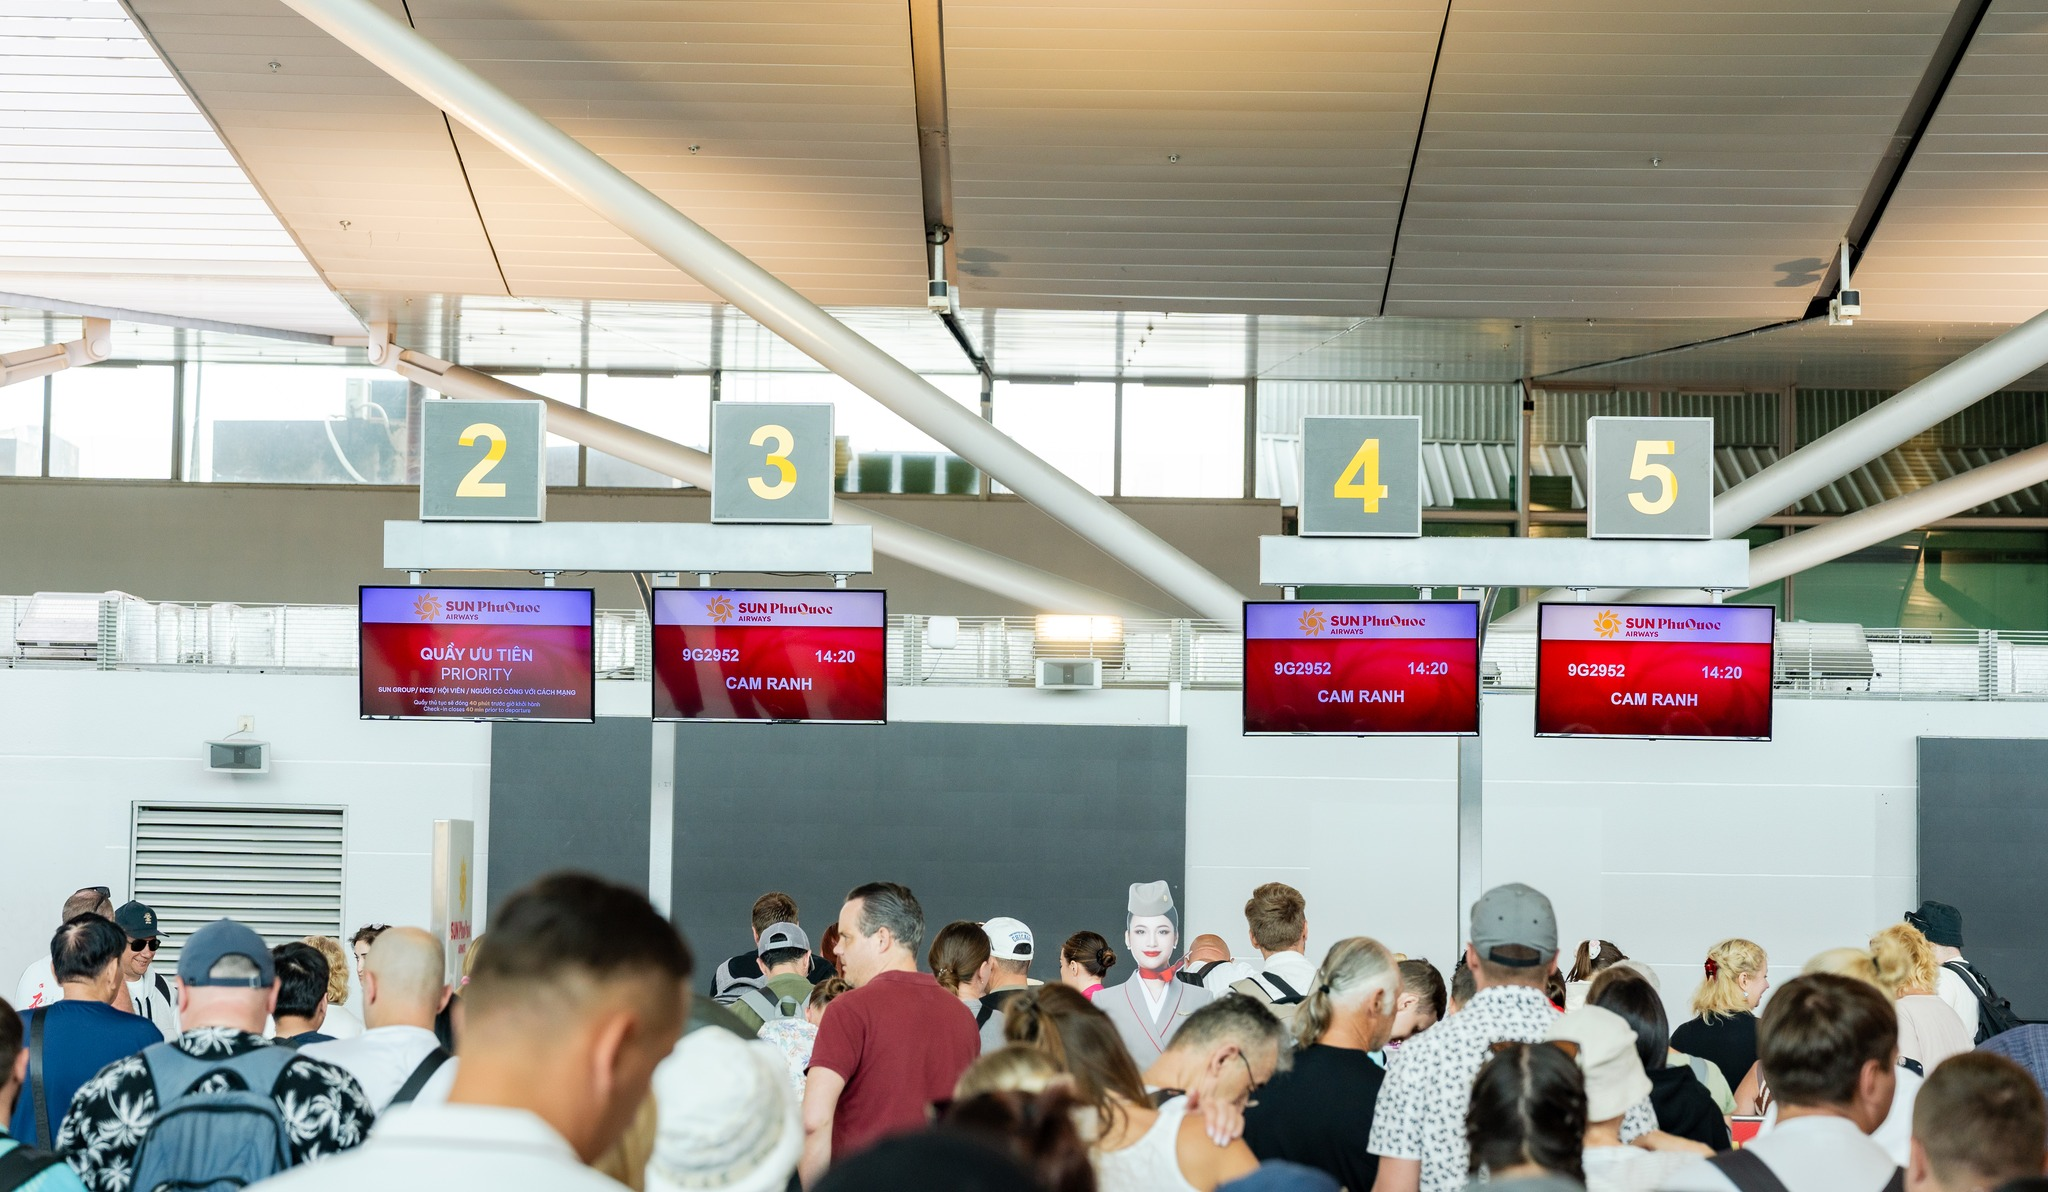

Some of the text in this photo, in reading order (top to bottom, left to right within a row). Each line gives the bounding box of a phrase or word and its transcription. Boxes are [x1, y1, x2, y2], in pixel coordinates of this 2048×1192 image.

[455, 422, 507, 498] 2
[747, 424, 798, 501] 3
[1333, 438, 1389, 514] 4
[1627, 440, 1679, 516] 5
[445, 601, 541, 614] SUN PhuQuoc
[738, 602, 833, 615] SUN PhuQuoc
[1330, 614, 1426, 628] SUN PhuQuoc
[1625, 617, 1721, 631] SUN PhuQuoc
[420, 642, 533, 662] QUẦY ƯU TIÊN
[682, 648, 856, 663] 9G2952 14:20
[441, 667, 513, 681] PRIORITY
[1274, 661, 1449, 675] 9G2952 14:20
[1567, 663, 1743, 679] 9G2952 14:20
[392, 686, 419, 694] GROUP/
[725, 677, 813, 690] CAM RANH
[1317, 689, 1405, 703] CAM RANH
[1610, 691, 1698, 706] CAM RANH
